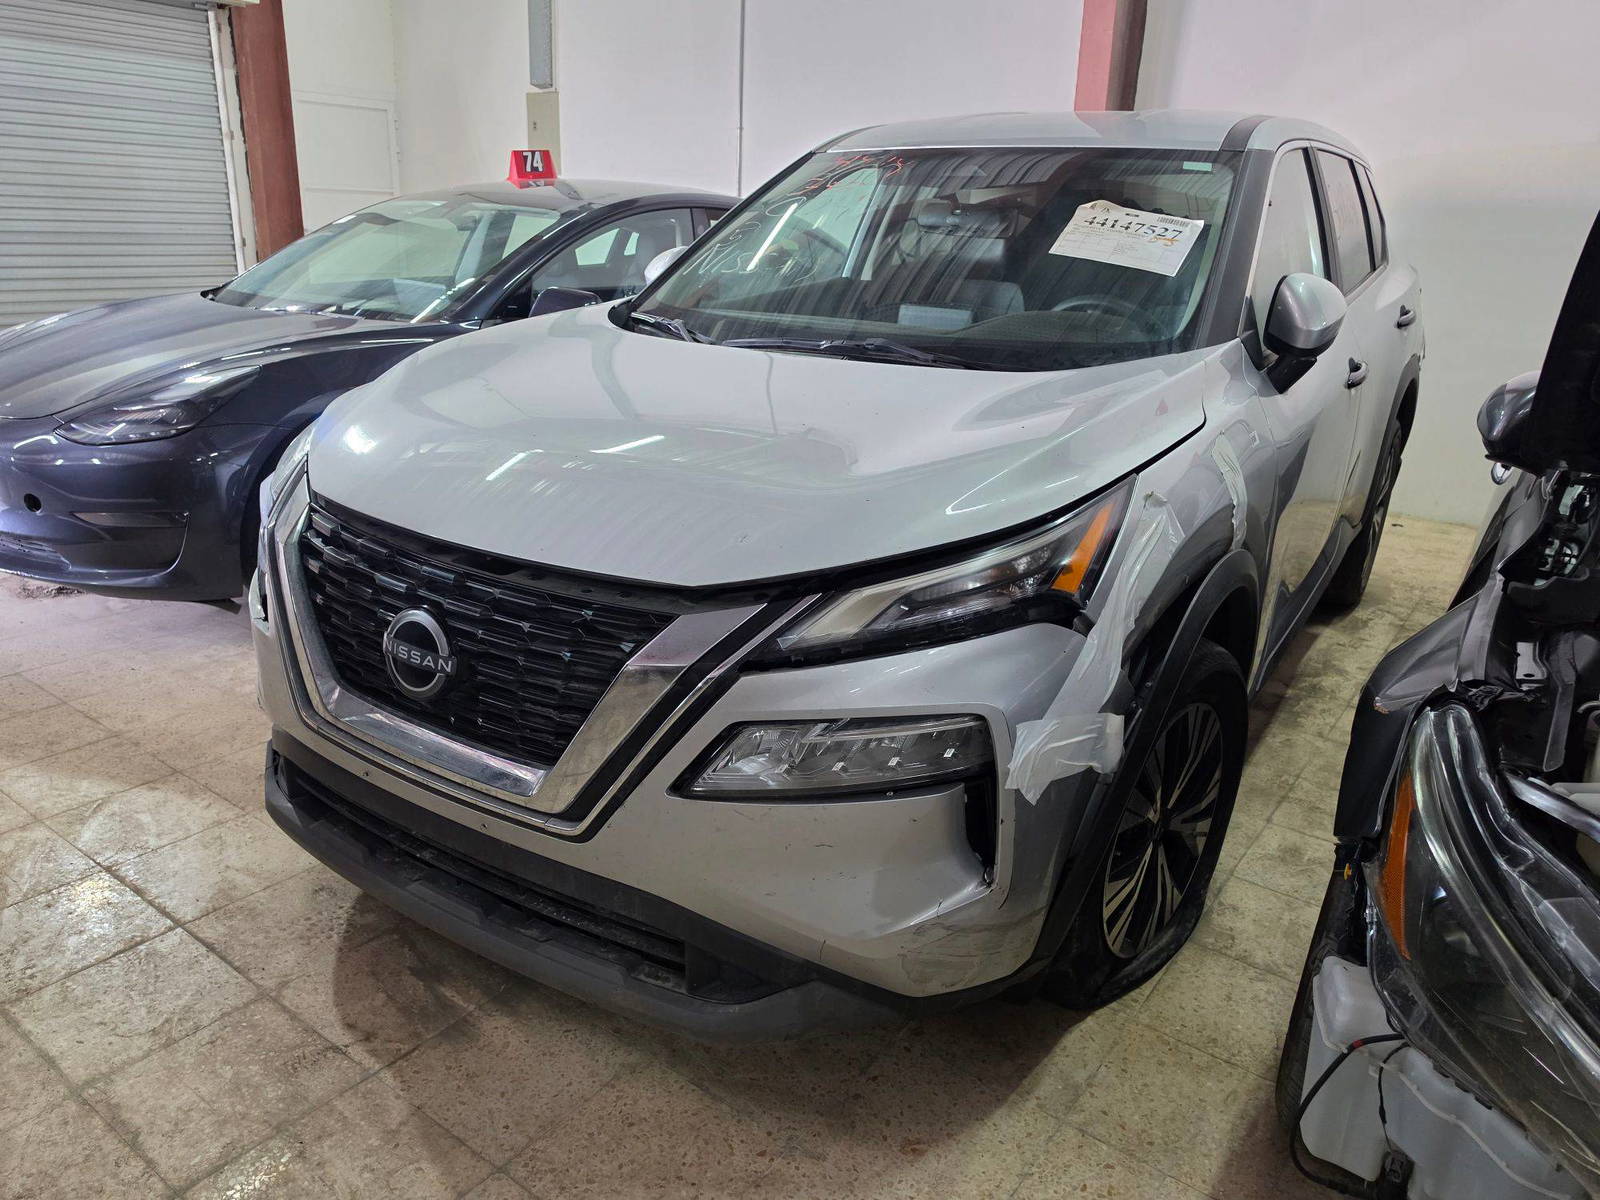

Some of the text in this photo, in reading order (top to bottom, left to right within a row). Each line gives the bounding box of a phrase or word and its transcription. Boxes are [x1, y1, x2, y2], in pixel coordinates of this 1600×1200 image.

[522, 151, 543, 172] 74
[1084, 216, 1183, 239] 44147527
[386, 640, 452, 672] NISSAN
